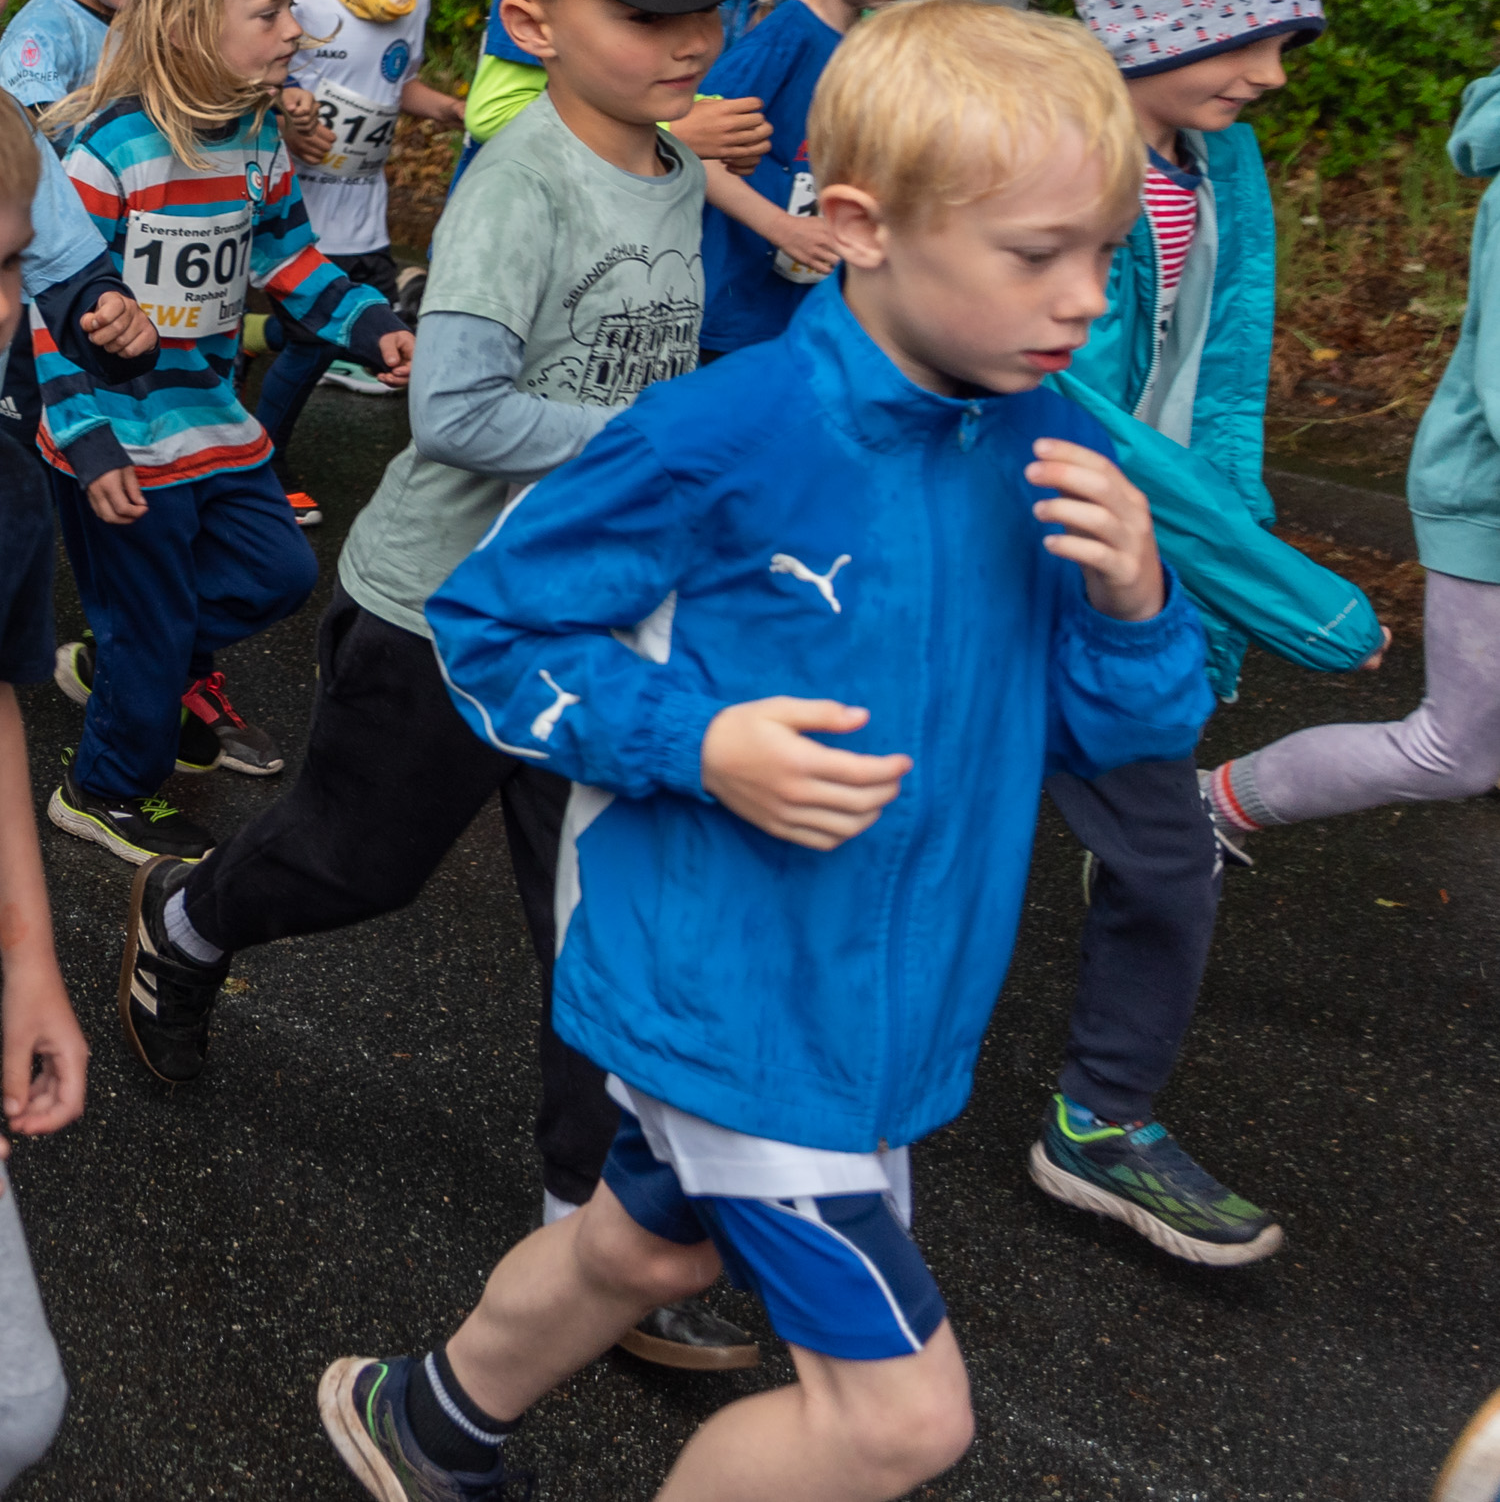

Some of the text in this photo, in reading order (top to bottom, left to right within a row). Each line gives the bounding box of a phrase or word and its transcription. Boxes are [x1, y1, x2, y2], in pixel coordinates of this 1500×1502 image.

[315, 50, 347, 59] JAKO
[140, 223, 212, 237] Everstener
[134, 232, 249, 288] 1607
[185, 288, 228, 303] Raphael
